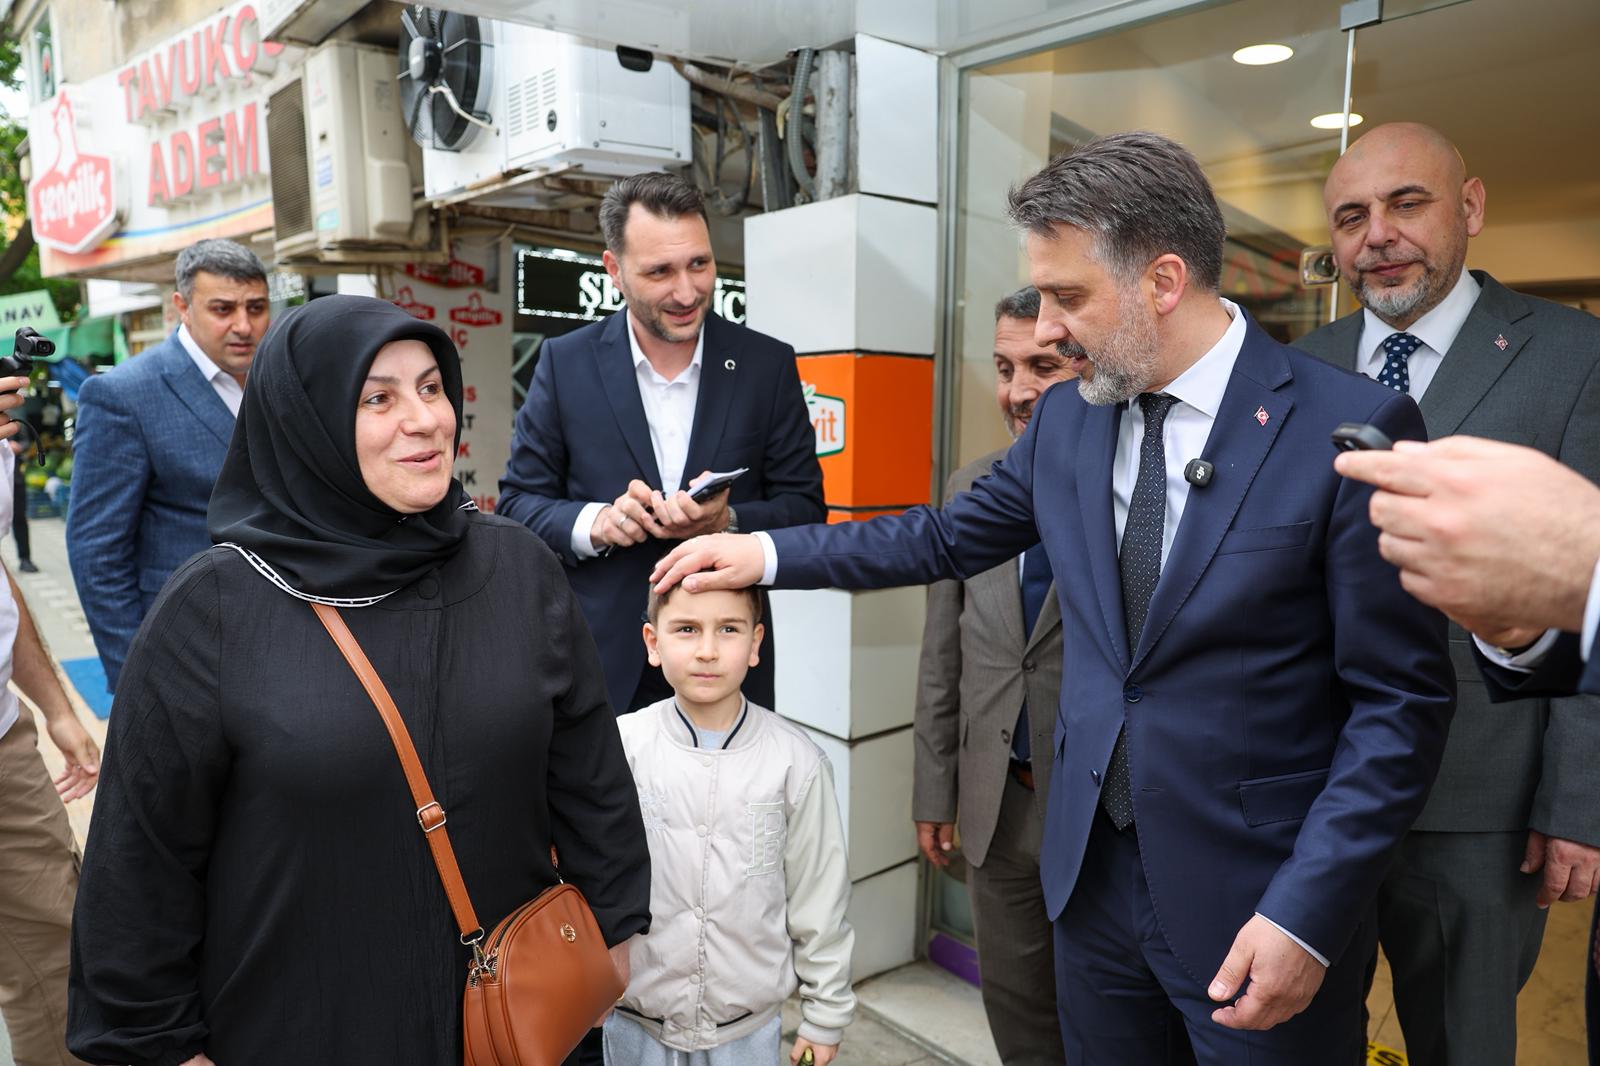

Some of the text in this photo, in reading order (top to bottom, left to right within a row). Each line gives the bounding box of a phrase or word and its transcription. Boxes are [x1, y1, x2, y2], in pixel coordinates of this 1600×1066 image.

[118, 5, 284, 125] TAVUKÇ
[147, 102, 260, 206] ADEM
[0, 304, 43, 323] NAV
